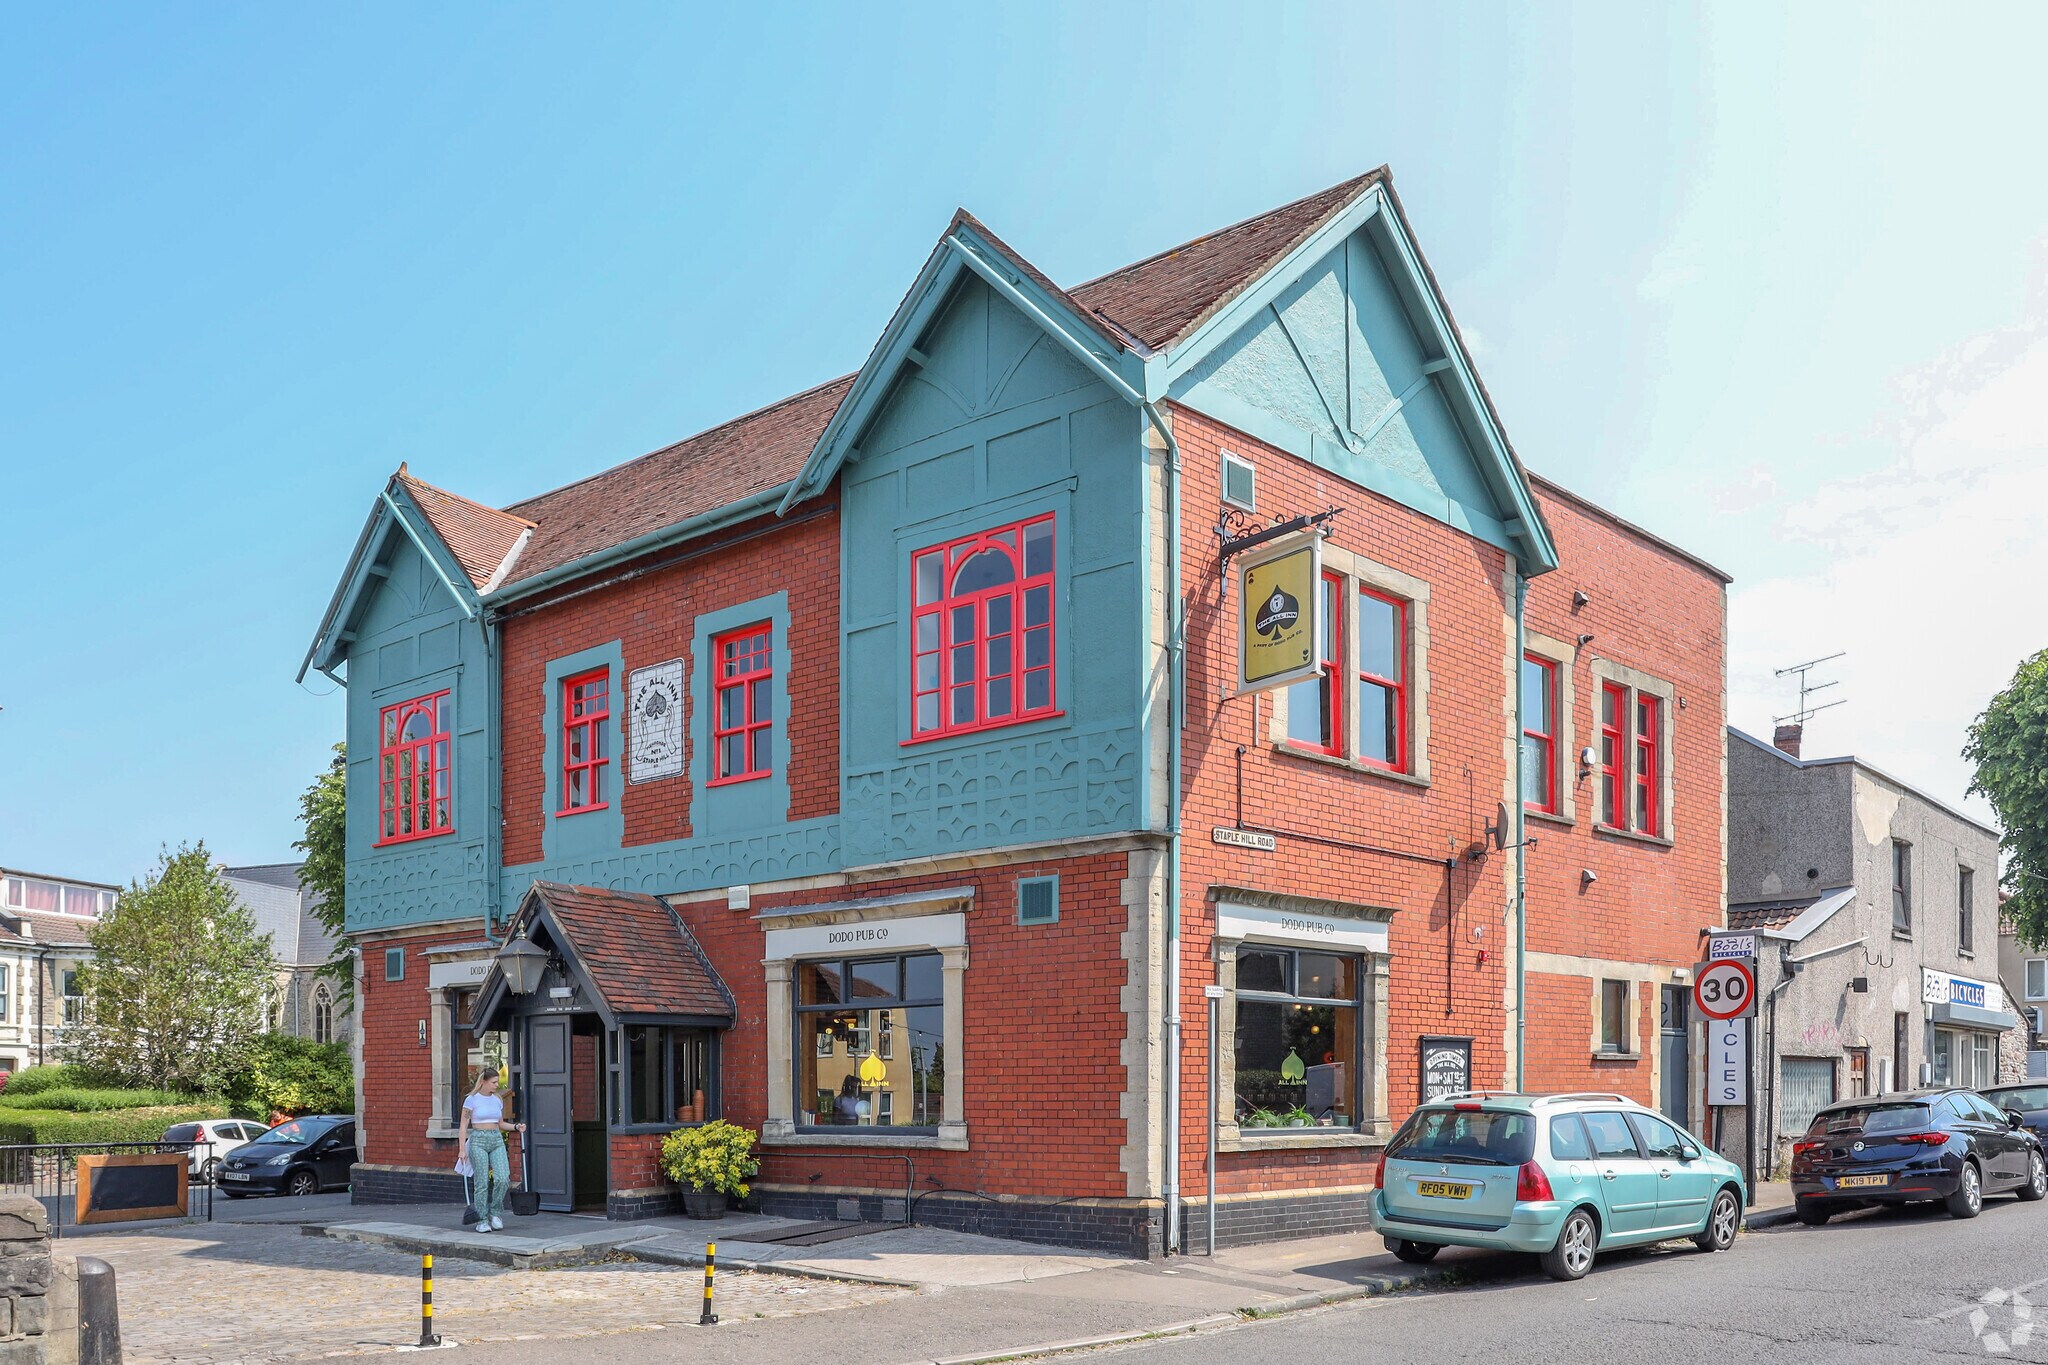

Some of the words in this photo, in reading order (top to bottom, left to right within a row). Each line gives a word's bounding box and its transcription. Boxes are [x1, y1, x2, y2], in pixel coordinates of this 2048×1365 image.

[1258, 619, 1270, 628] THE
[635, 686, 648, 712] THE
[649, 677, 665, 687] ALL
[667, 681, 679, 702] INN
[1214, 830, 1240, 842] STAPLE
[1241, 834, 1256, 845] HILL
[1257, 836, 1274, 848] ROAD
[1281, 917, 1304, 932] DODO
[1306, 920, 1323, 933] PUB
[828, 931, 854, 944] DODO
[856, 929, 875, 942] PUB
[470, 966, 487, 976] DODO
[1703, 976, 1745, 1002] 30
[1950, 982, 1984, 1005] BICYCLES
[1429, 1052, 1448, 1065] OPENING
[1448, 1052, 1461, 1064] TIMES
[1723, 1018, 1738, 1100] YCLES
[1443, 1071, 1454, 1085] SAT
[1427, 1085, 1452, 1097] SUNDAY
[1844, 1177, 1865, 1186] MK19
[1866, 1176, 1884, 1184] TPV
[1420, 1183, 1445, 1195] RF05
[1447, 1184, 1468, 1196] VWH
